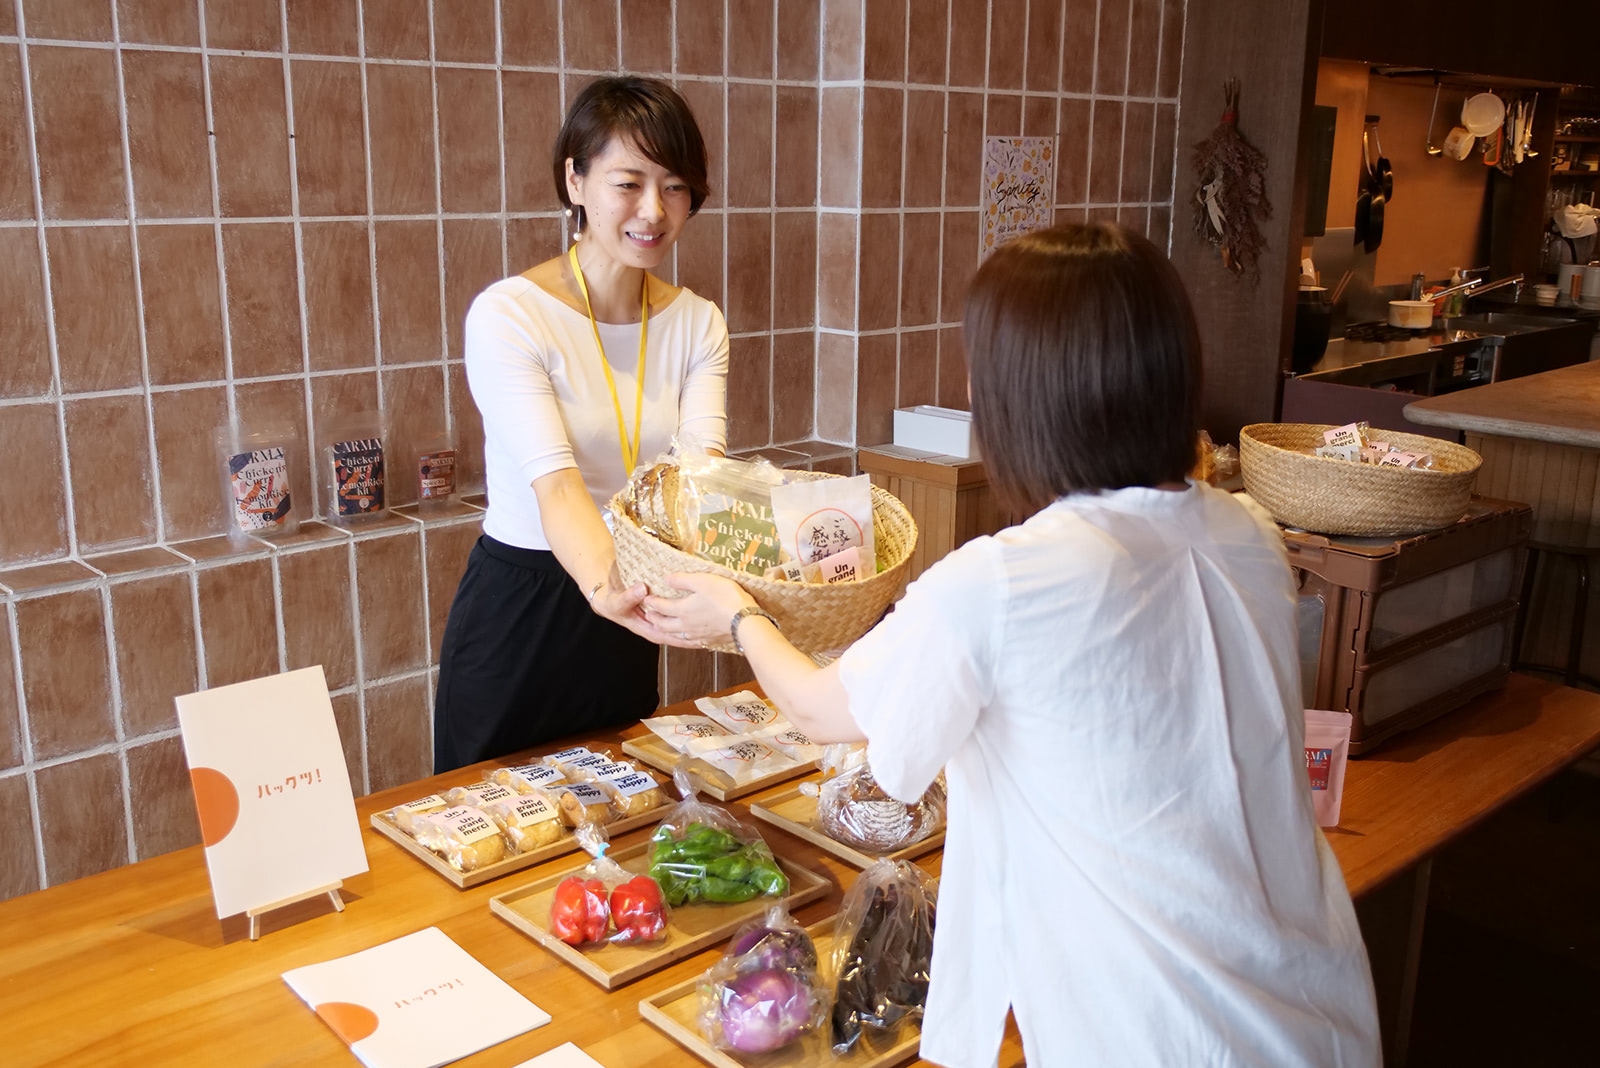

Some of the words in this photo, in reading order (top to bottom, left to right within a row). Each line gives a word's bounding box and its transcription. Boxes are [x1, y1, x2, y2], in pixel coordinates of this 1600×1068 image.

[340, 456, 380, 467] Chicken
[705, 519, 774, 546] Chicken
[828, 566, 856, 584] grand
[834, 564, 849, 574] Un
[526, 769, 555, 782] happy
[597, 766, 627, 776] happy
[618, 777, 648, 789] happy
[480, 787, 506, 799] grand
[485, 791, 511, 802] merci
[516, 800, 543, 813] grand
[521, 804, 548, 818] merci
[457, 817, 484, 832] grand
[463, 822, 489, 836] merci
